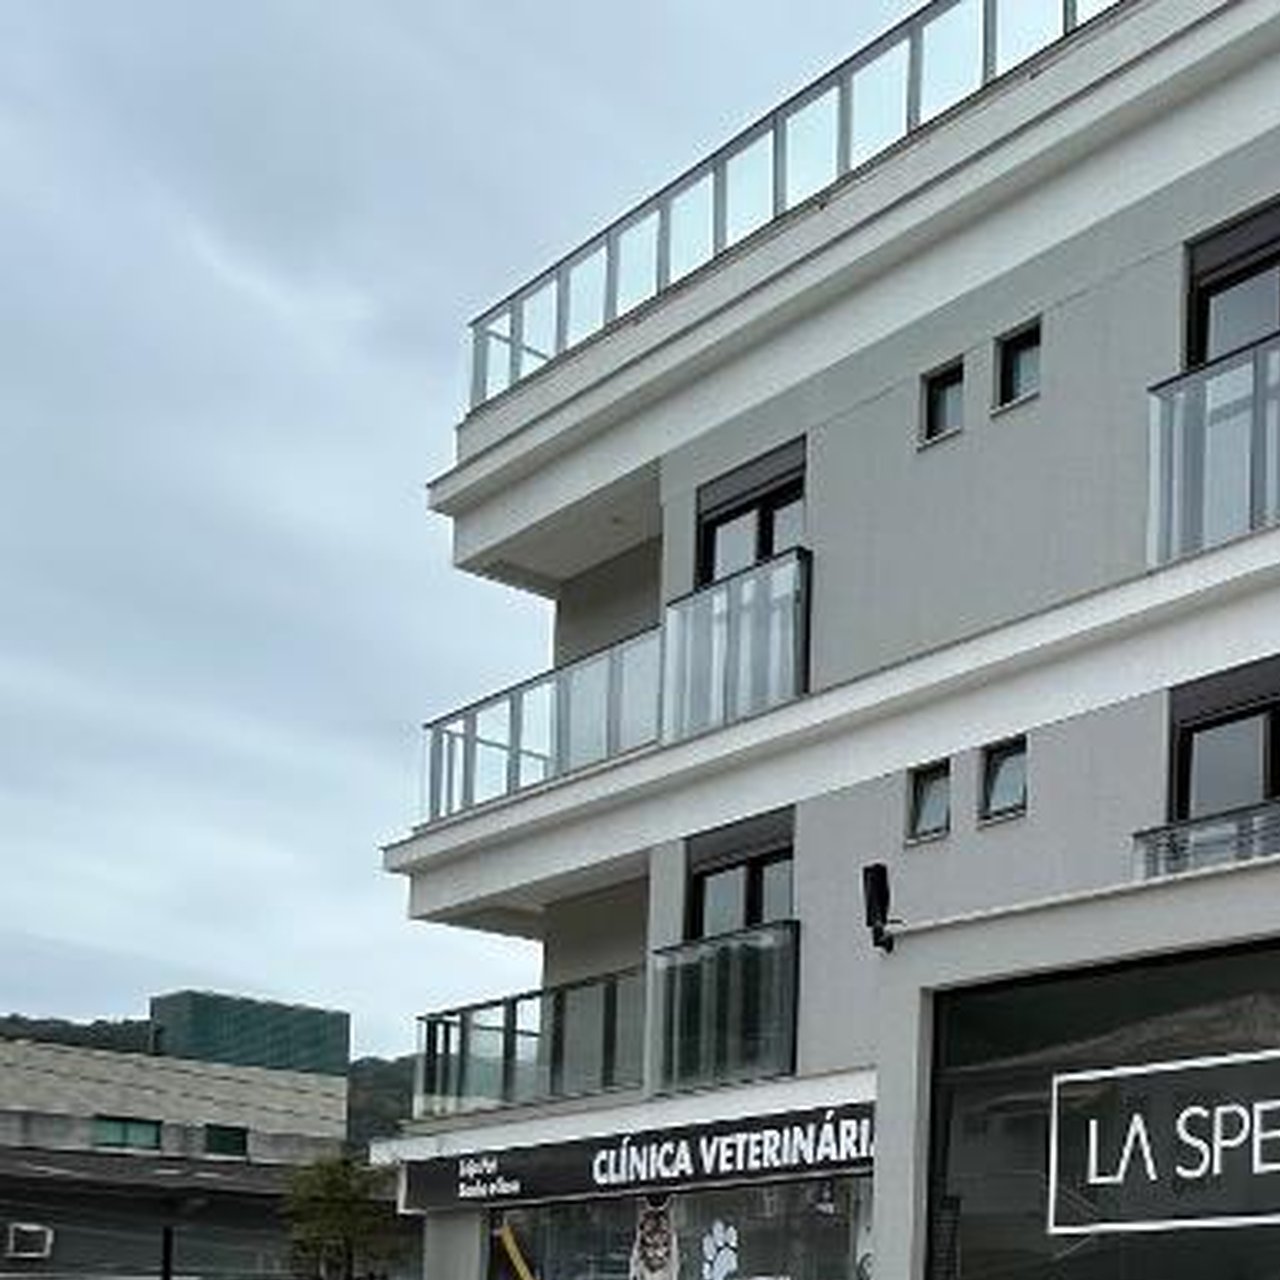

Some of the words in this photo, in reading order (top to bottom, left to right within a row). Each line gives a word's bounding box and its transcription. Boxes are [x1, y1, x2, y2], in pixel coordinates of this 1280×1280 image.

[592, 1136, 694, 1184] CLÍNICA
[699, 1110, 875, 1174] VETERINÁRI
[1087, 1113, 1158, 1184] LA
